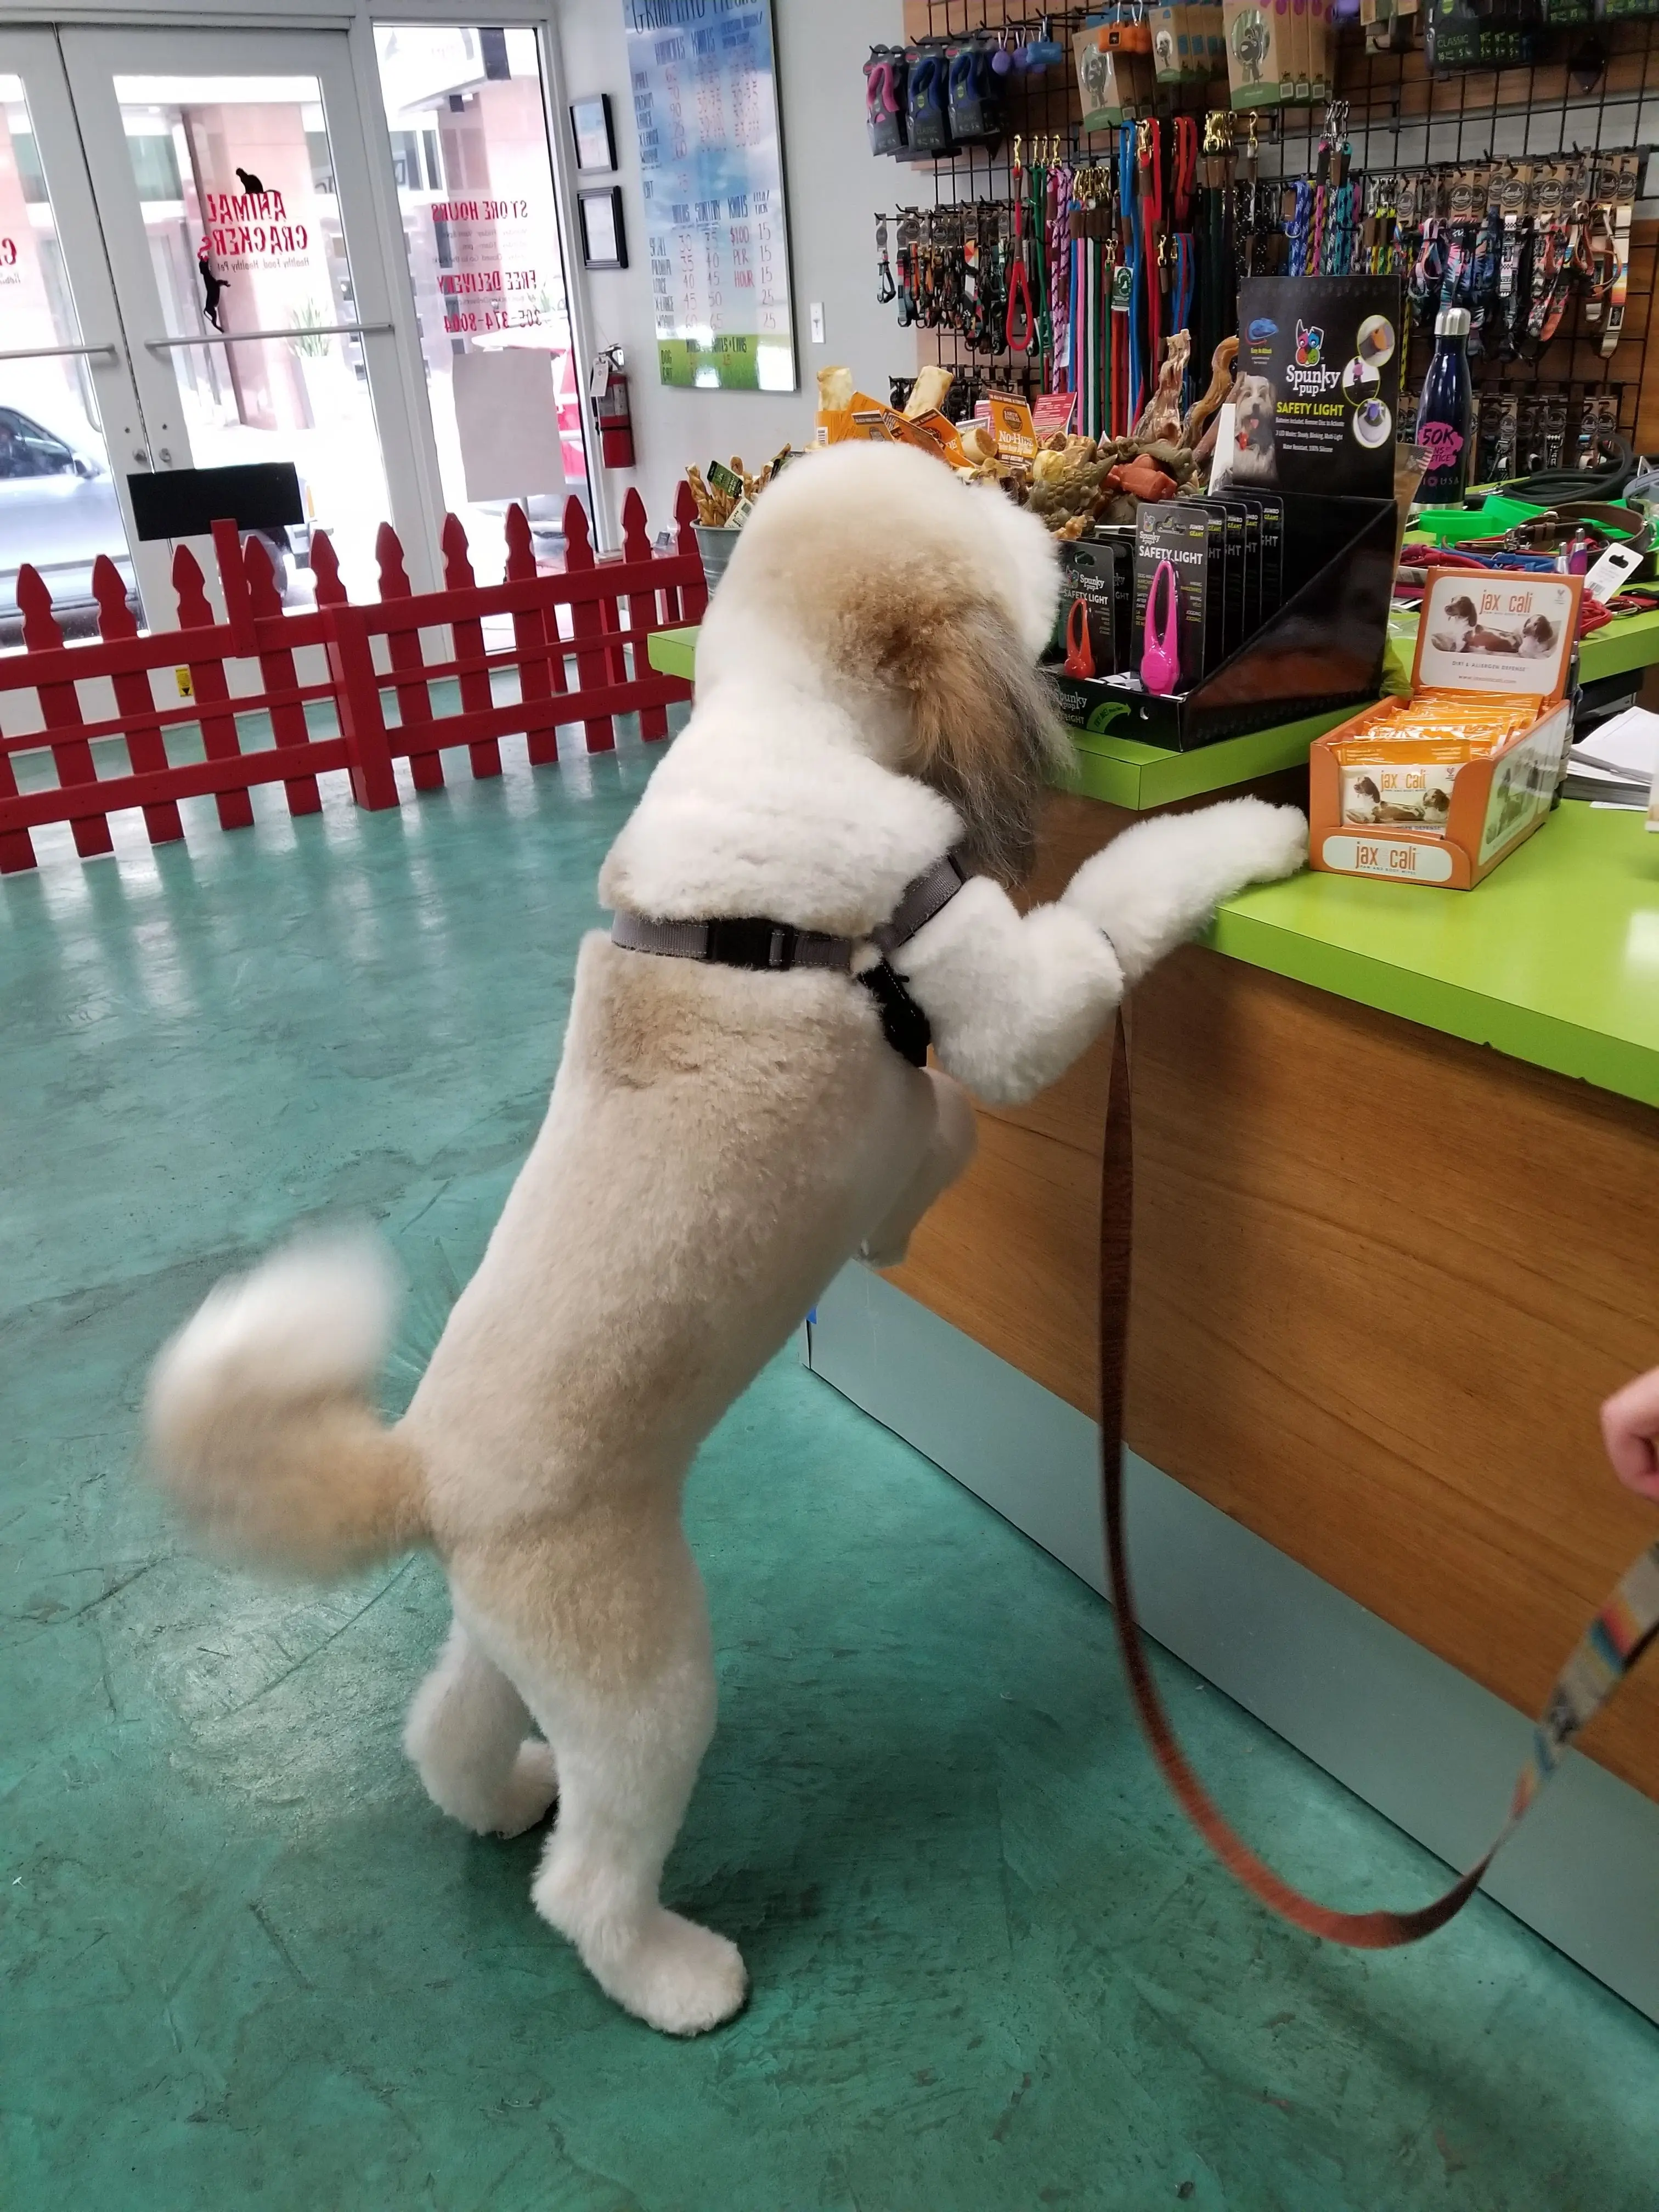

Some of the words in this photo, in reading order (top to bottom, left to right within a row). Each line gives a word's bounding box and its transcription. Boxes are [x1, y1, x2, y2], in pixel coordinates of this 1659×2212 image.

[755, 204, 768, 215] TICK
[730, 225, 749, 247] $100
[758, 222, 771, 240] 15
[681, 255, 694, 272] 35
[706, 252, 719, 268] 40
[733, 249, 749, 266] PER
[760, 245, 772, 262] 15
[683, 273, 695, 289] 40
[707, 271, 720, 286] 45
[735, 270, 755, 288] HOUR
[761, 266, 773, 284] 15
[684, 293, 697, 310] 45
[708, 291, 722, 307] 50
[762, 289, 774, 306] 25
[710, 313, 724, 330] 65
[764, 312, 776, 329] 25
[661, 349, 672, 365] DOG
[1286, 364, 1341, 393] Spunky
[1299, 386, 1319, 397] pup
[1276, 401, 1312, 415] SAFETY
[1313, 403, 1345, 416] LIGHT
[1422, 428, 1454, 446] 50K
[1139, 531, 1160, 544] Spunky
[1139, 545, 1172, 559] SAFETY
[1175, 550, 1203, 565] LIGHT
[1080, 574, 1105, 591] Spunky
[1064, 589, 1087, 601] SAFETY
[1088, 594, 1108, 605] LIGHT
[1115, 590, 1129, 601] GHT
[1479, 589, 1501, 615] jax
[1509, 590, 1533, 613] cali
[1380, 770, 1398, 792] jax
[1406, 769, 1426, 789] cali
[1355, 841, 1379, 869] jax
[1390, 846, 1417, 871] cali
